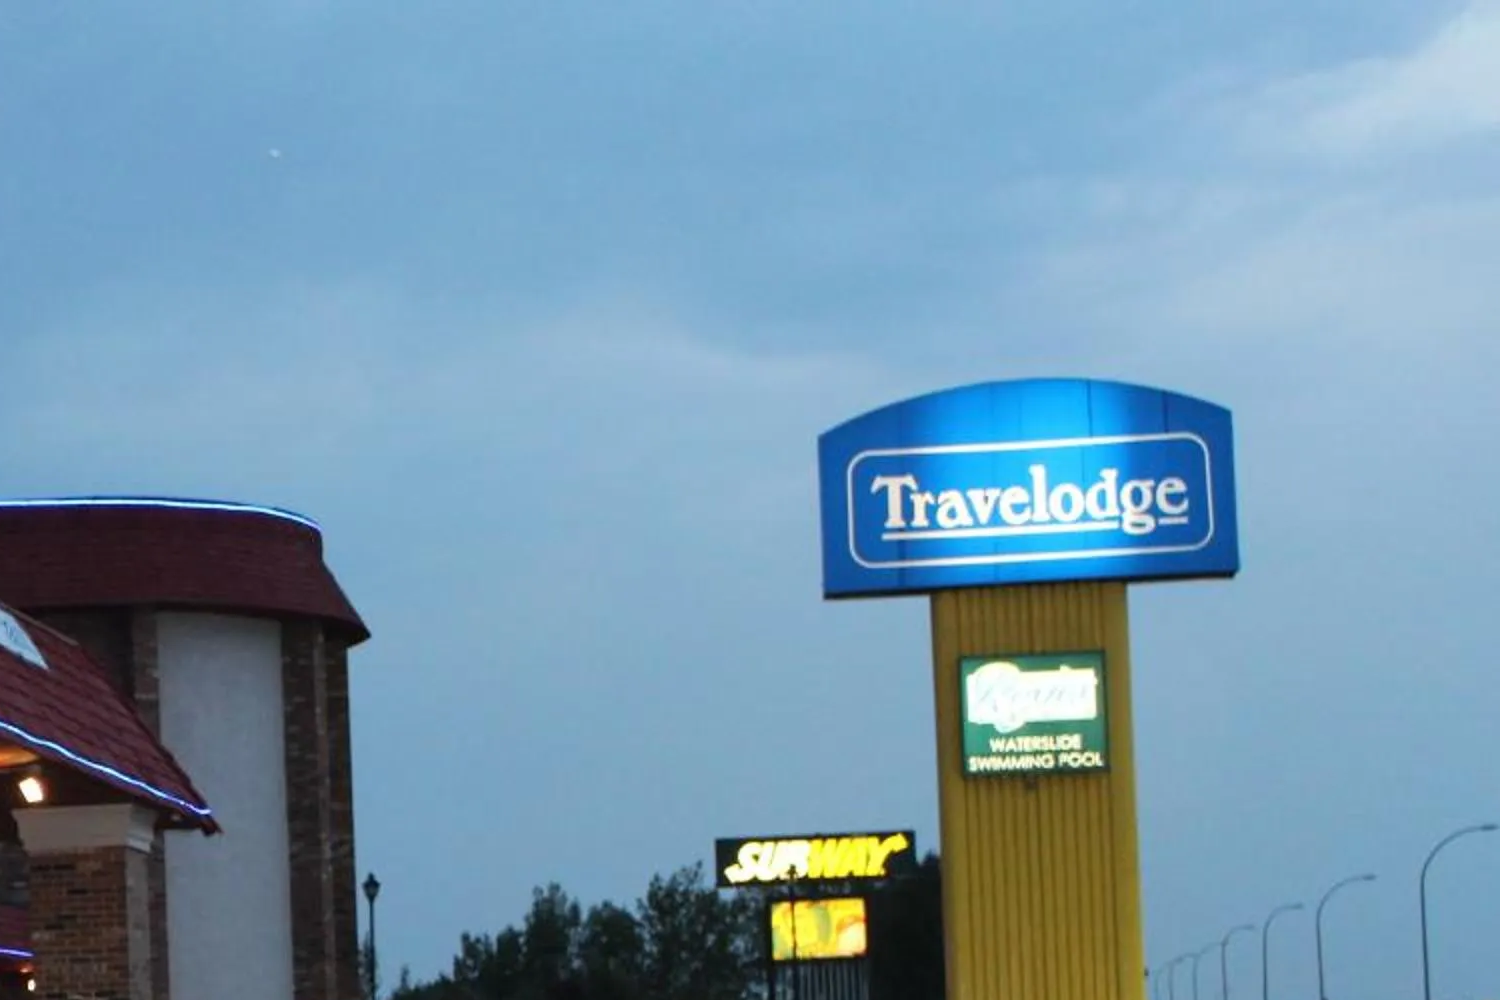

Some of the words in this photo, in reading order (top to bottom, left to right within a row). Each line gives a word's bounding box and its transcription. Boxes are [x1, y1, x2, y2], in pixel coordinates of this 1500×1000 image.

[871, 464, 1189, 535] Travelodge
[989, 733, 1082, 752] WATERSLIDE
[968, 754, 1056, 772] SWIMMING
[1058, 751, 1104, 767] POOL
[724, 833, 908, 883] SUBWAY
